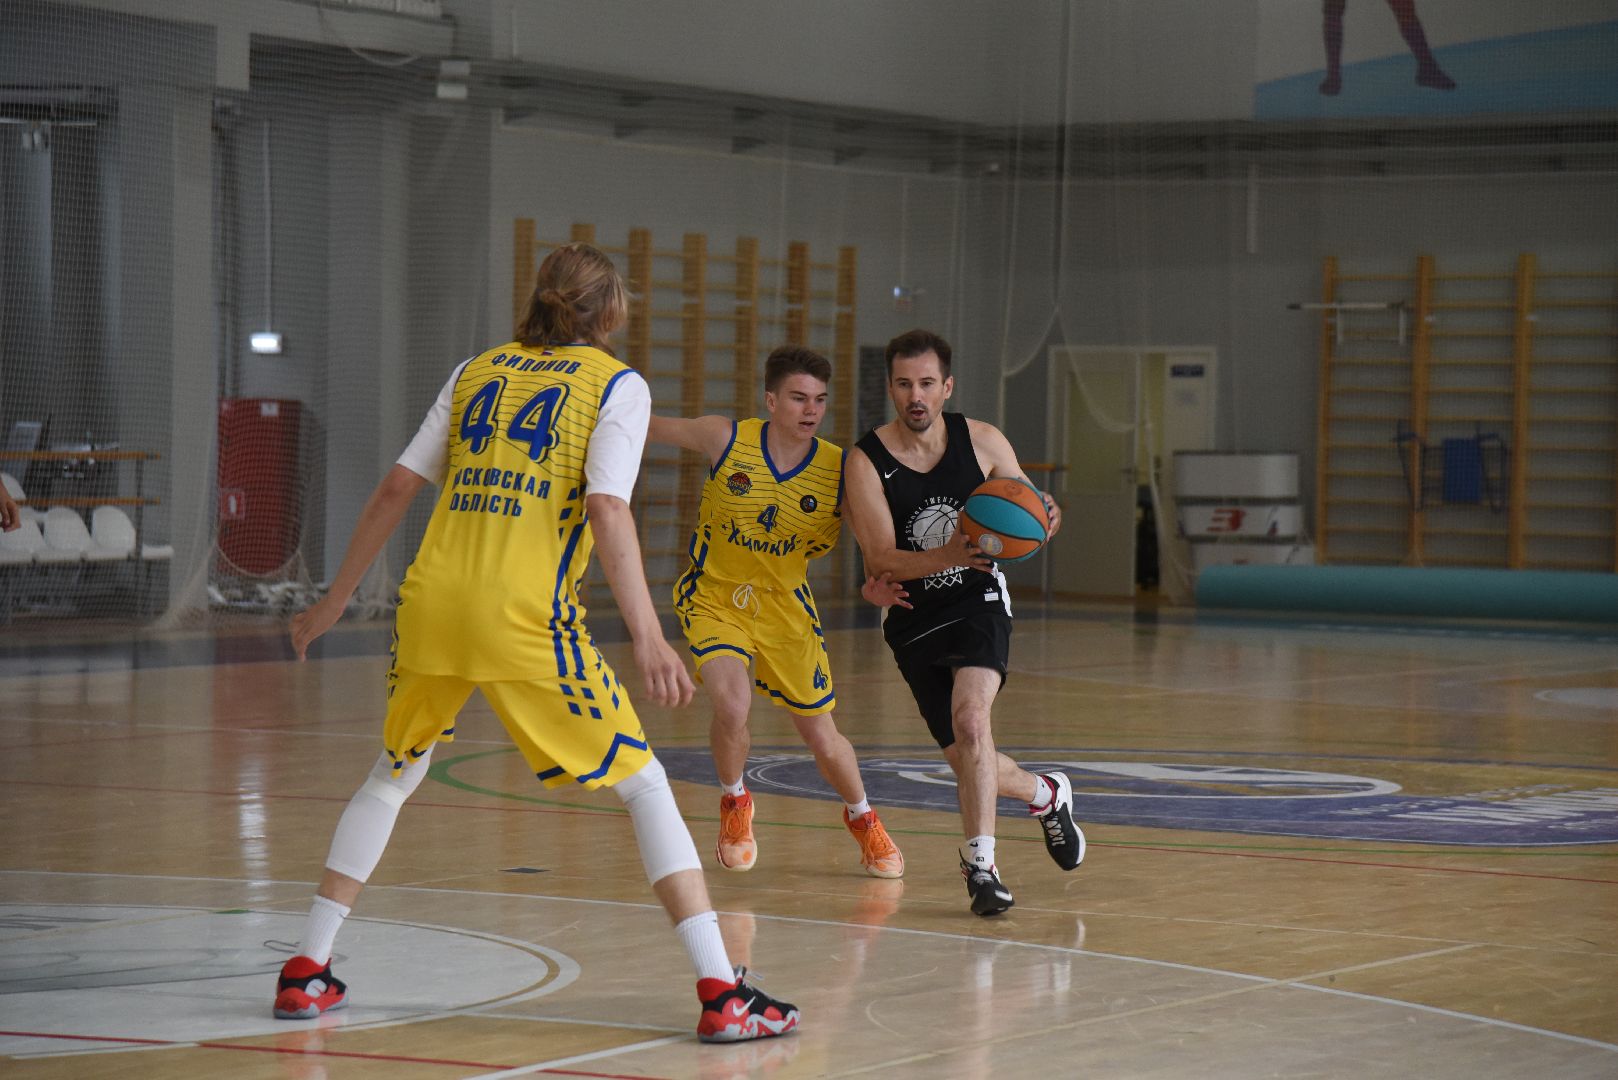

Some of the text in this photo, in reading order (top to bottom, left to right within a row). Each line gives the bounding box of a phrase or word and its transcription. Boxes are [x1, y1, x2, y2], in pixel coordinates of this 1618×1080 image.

[491, 353, 582, 375] ФИЛОНОВ
[460, 375, 571, 464] 44
[451, 467, 552, 500] СКОВСКАЯ
[756, 504, 779, 533] 4
[727, 518, 798, 557] ХИМКИ
[813, 661, 829, 691] 4
